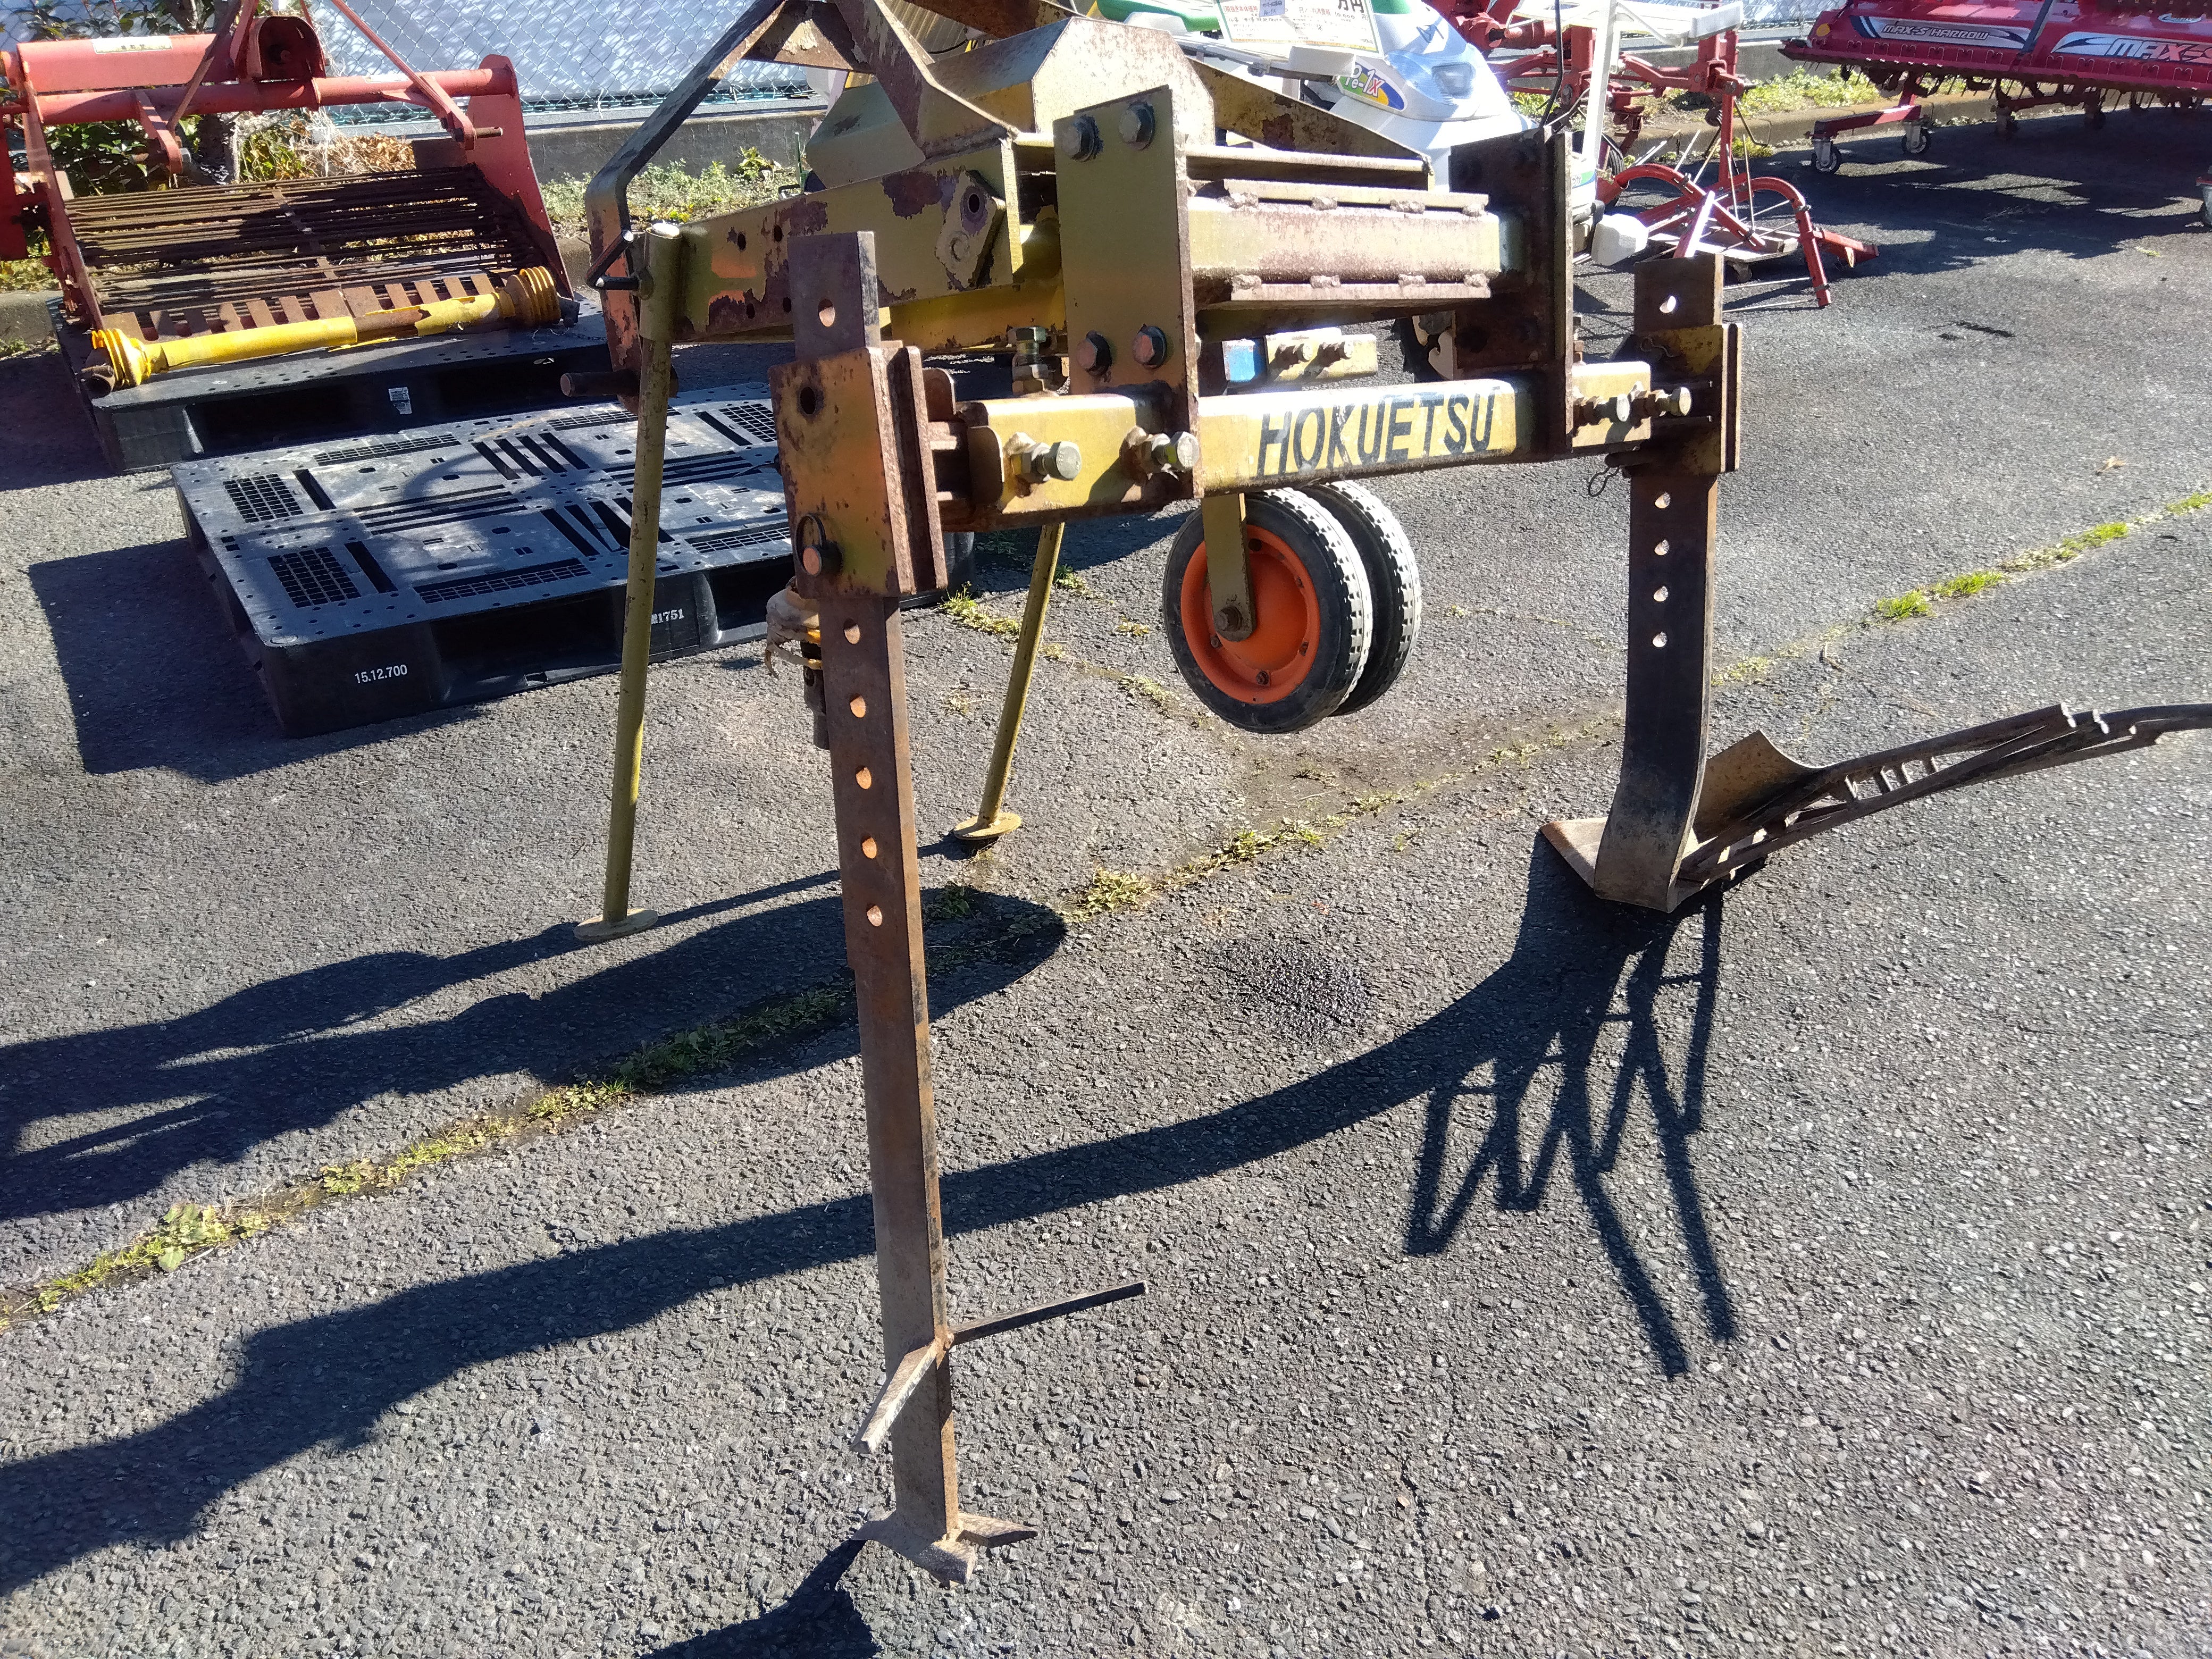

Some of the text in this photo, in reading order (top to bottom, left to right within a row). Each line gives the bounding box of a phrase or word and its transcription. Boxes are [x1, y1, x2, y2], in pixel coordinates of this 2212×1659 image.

[1882, 24, 1990, 40] MAX-S HARROW
[1255, 386, 1501, 478] HOKUETSU
[355, 664, 408, 684] 15.12.700
